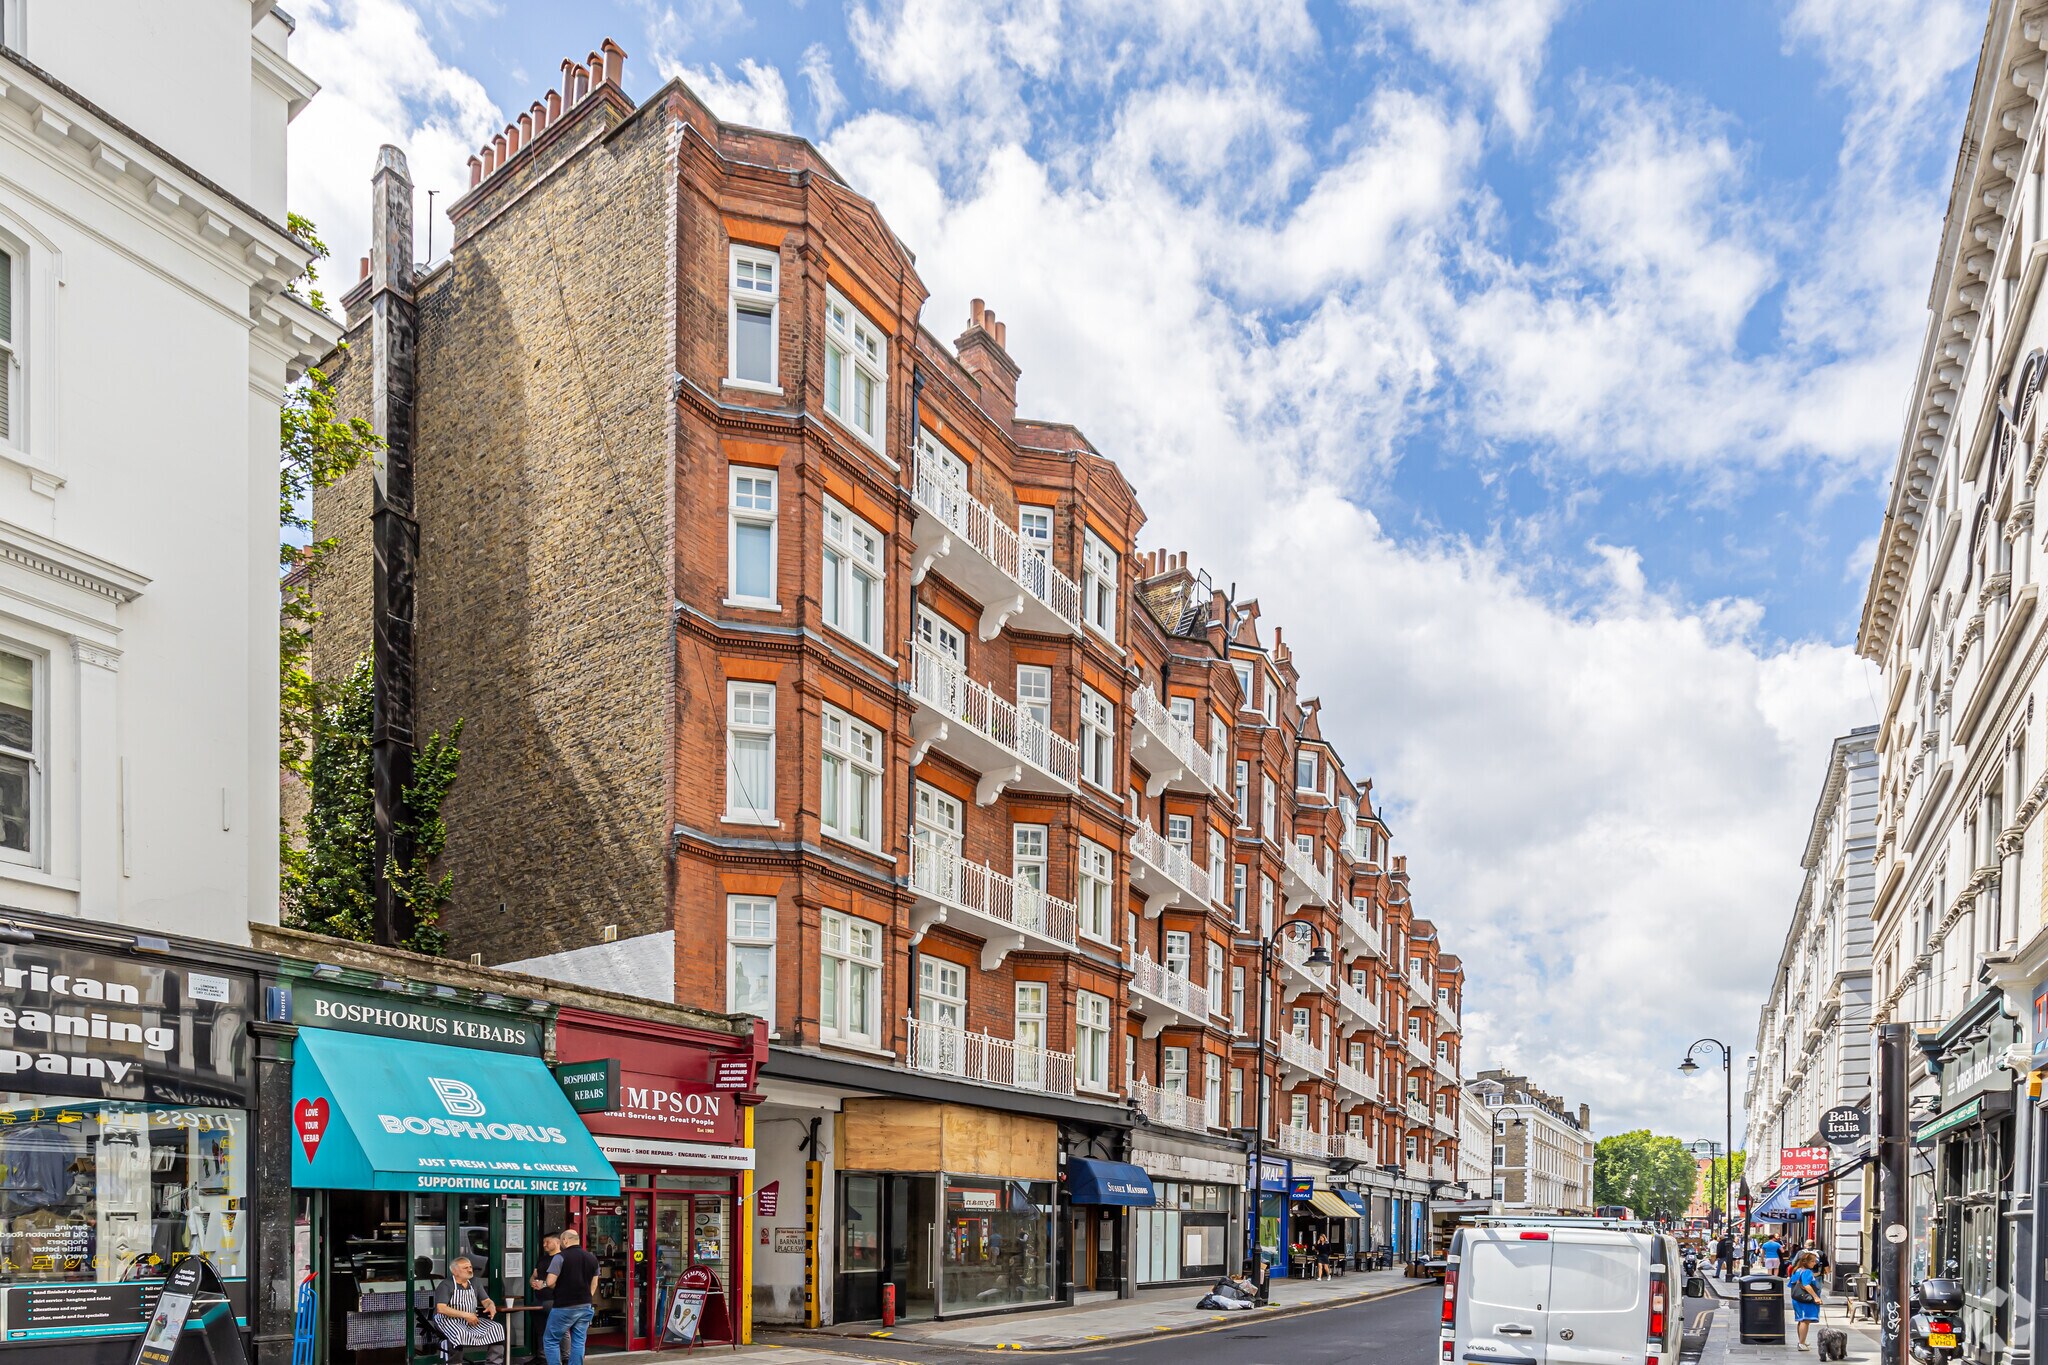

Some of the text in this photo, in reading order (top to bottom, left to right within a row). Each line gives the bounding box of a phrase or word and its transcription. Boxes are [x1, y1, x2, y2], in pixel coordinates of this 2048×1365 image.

[0, 965, 139, 1004] rican
[315, 999, 526, 1046] BOSPHORUS KEBABS
[563, 1072, 605, 1085] BOSPHORUS
[574, 1088, 604, 1101] KEBABS
[305, 1108, 318, 1116] LOVE
[1829, 1111, 1859, 1122] Bella
[305, 1121, 318, 1129] YOUR
[628, 1112, 656, 1121] Service
[658, 1114, 667, 1123] By
[691, 1118, 714, 1126] People
[377, 1114, 567, 1144] BOSPHORUS
[1828, 1122, 1859, 1133] Italia
[303, 1134, 319, 1142] KEBAB
[1782, 1149, 1811, 1158] To Let
[418, 1158, 578, 1172] JUST FRESH LAMB & CHICKEN
[418, 1176, 587, 1192] SUPPORTING LOCAL SINCE 1974
[683, 1270, 708, 1281] TIMPSON
